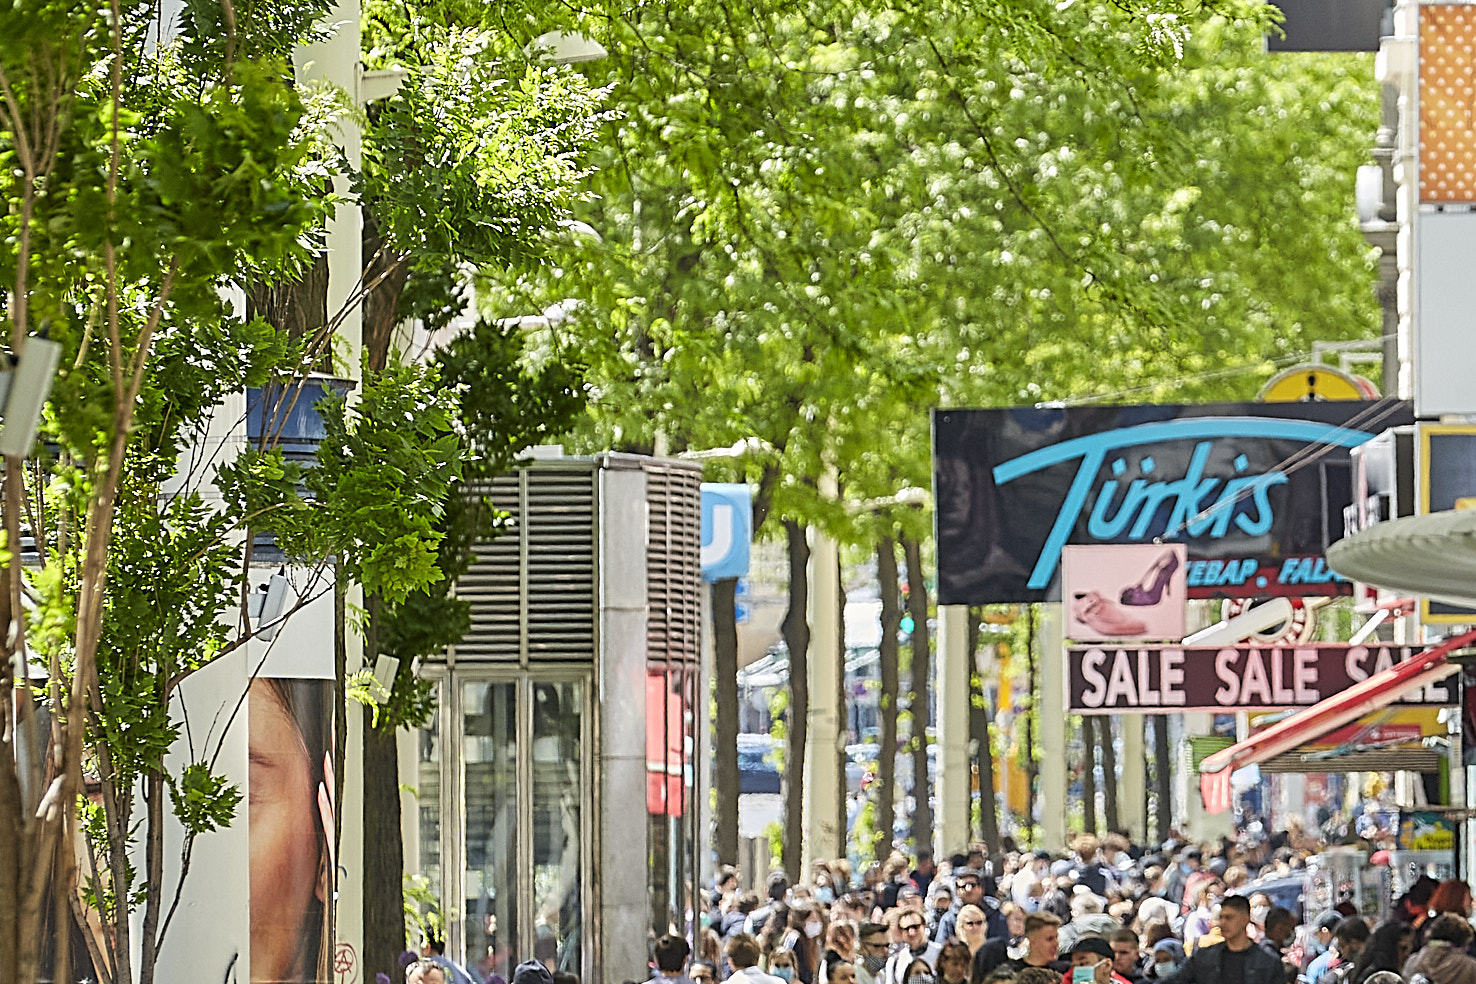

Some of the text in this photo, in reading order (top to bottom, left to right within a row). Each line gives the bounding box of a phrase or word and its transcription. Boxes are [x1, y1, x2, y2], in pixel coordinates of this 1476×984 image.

[993, 416, 1376, 590] Türkis
[1081, 647, 1186, 708] SALE
[1214, 646, 1321, 706] SALE
